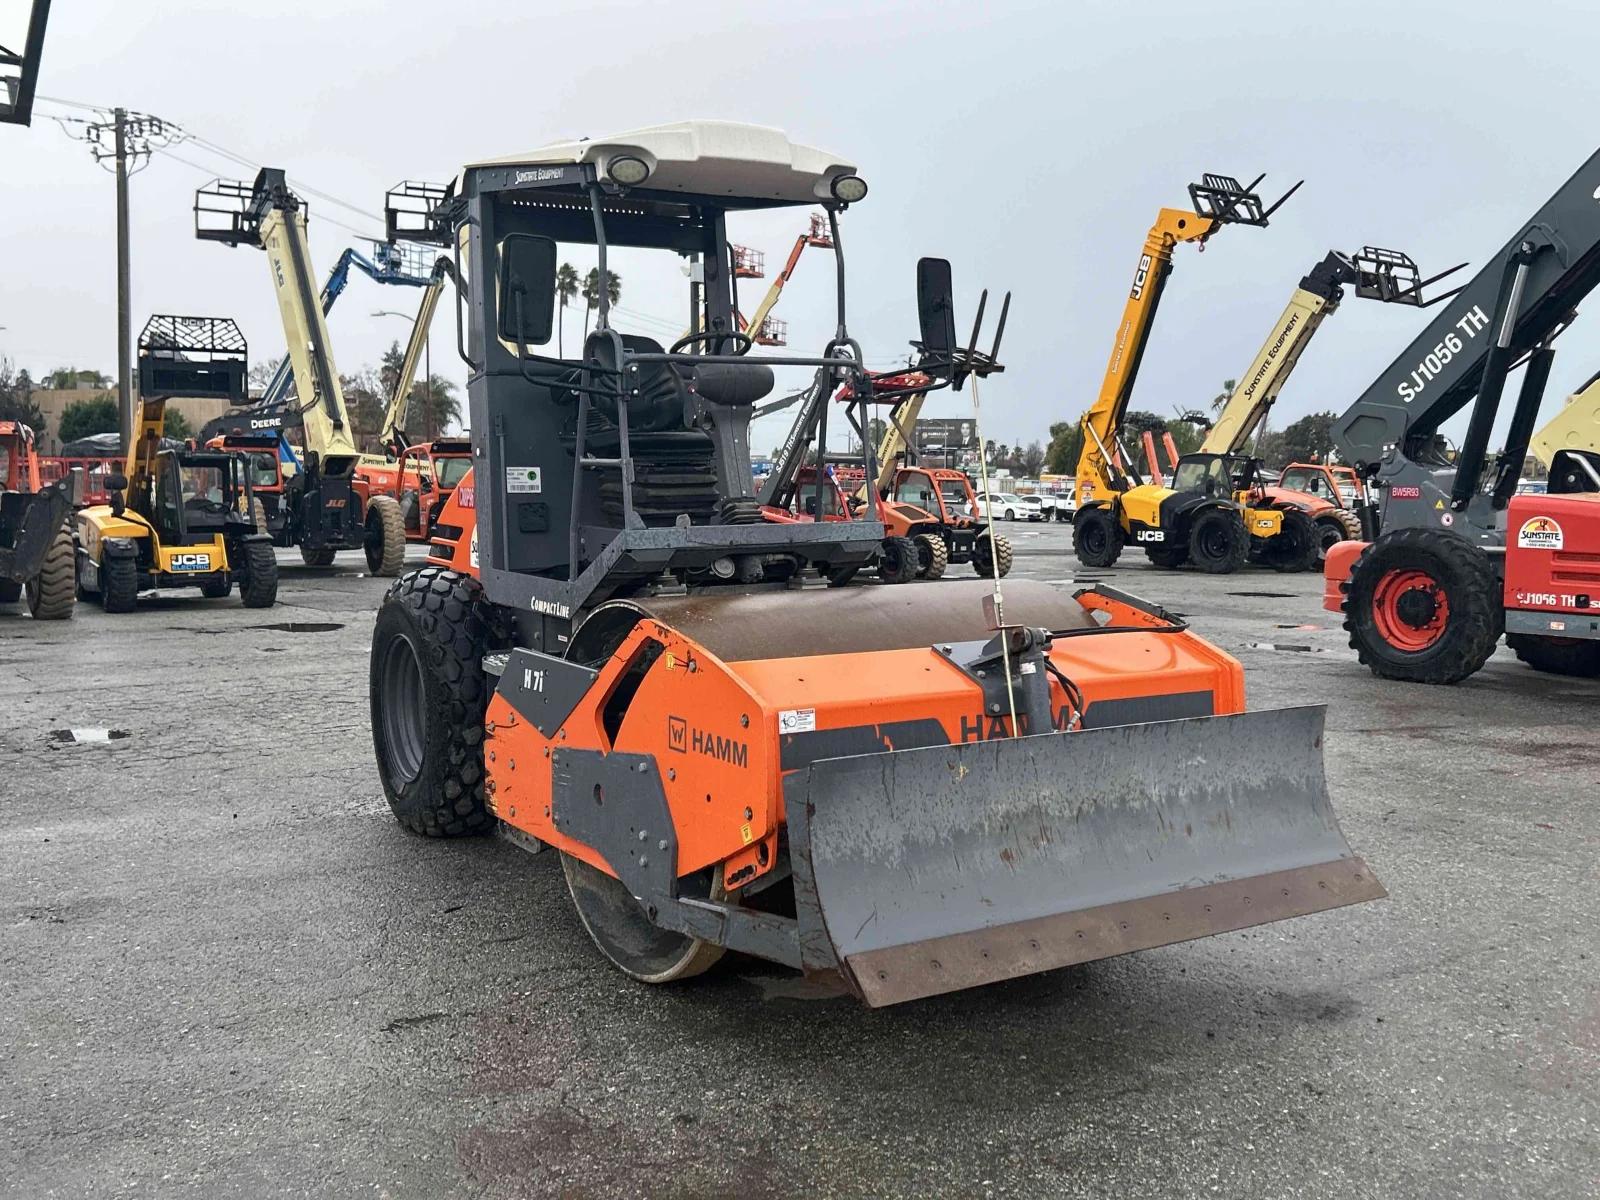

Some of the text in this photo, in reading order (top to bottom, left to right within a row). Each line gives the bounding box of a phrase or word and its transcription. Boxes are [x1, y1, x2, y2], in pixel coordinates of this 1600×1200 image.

[1132, 254, 1152, 300] JCB
[1244, 312, 1299, 401] SUNSTATE EQUIPMENT
[1397, 304, 1490, 403] SJ1056 TH
[250, 417, 282, 429] DEERE
[325, 499, 347, 508] JLG
[1257, 520, 1274, 528] JCB
[1136, 530, 1165, 542] JCB
[1520, 530, 1561, 541] SUNSTATE
[171, 554, 210, 566] JCB
[1560, 594, 1576, 607] TH
[523, 668, 544, 693] H 7i
[692, 727, 748, 769] HAMM
